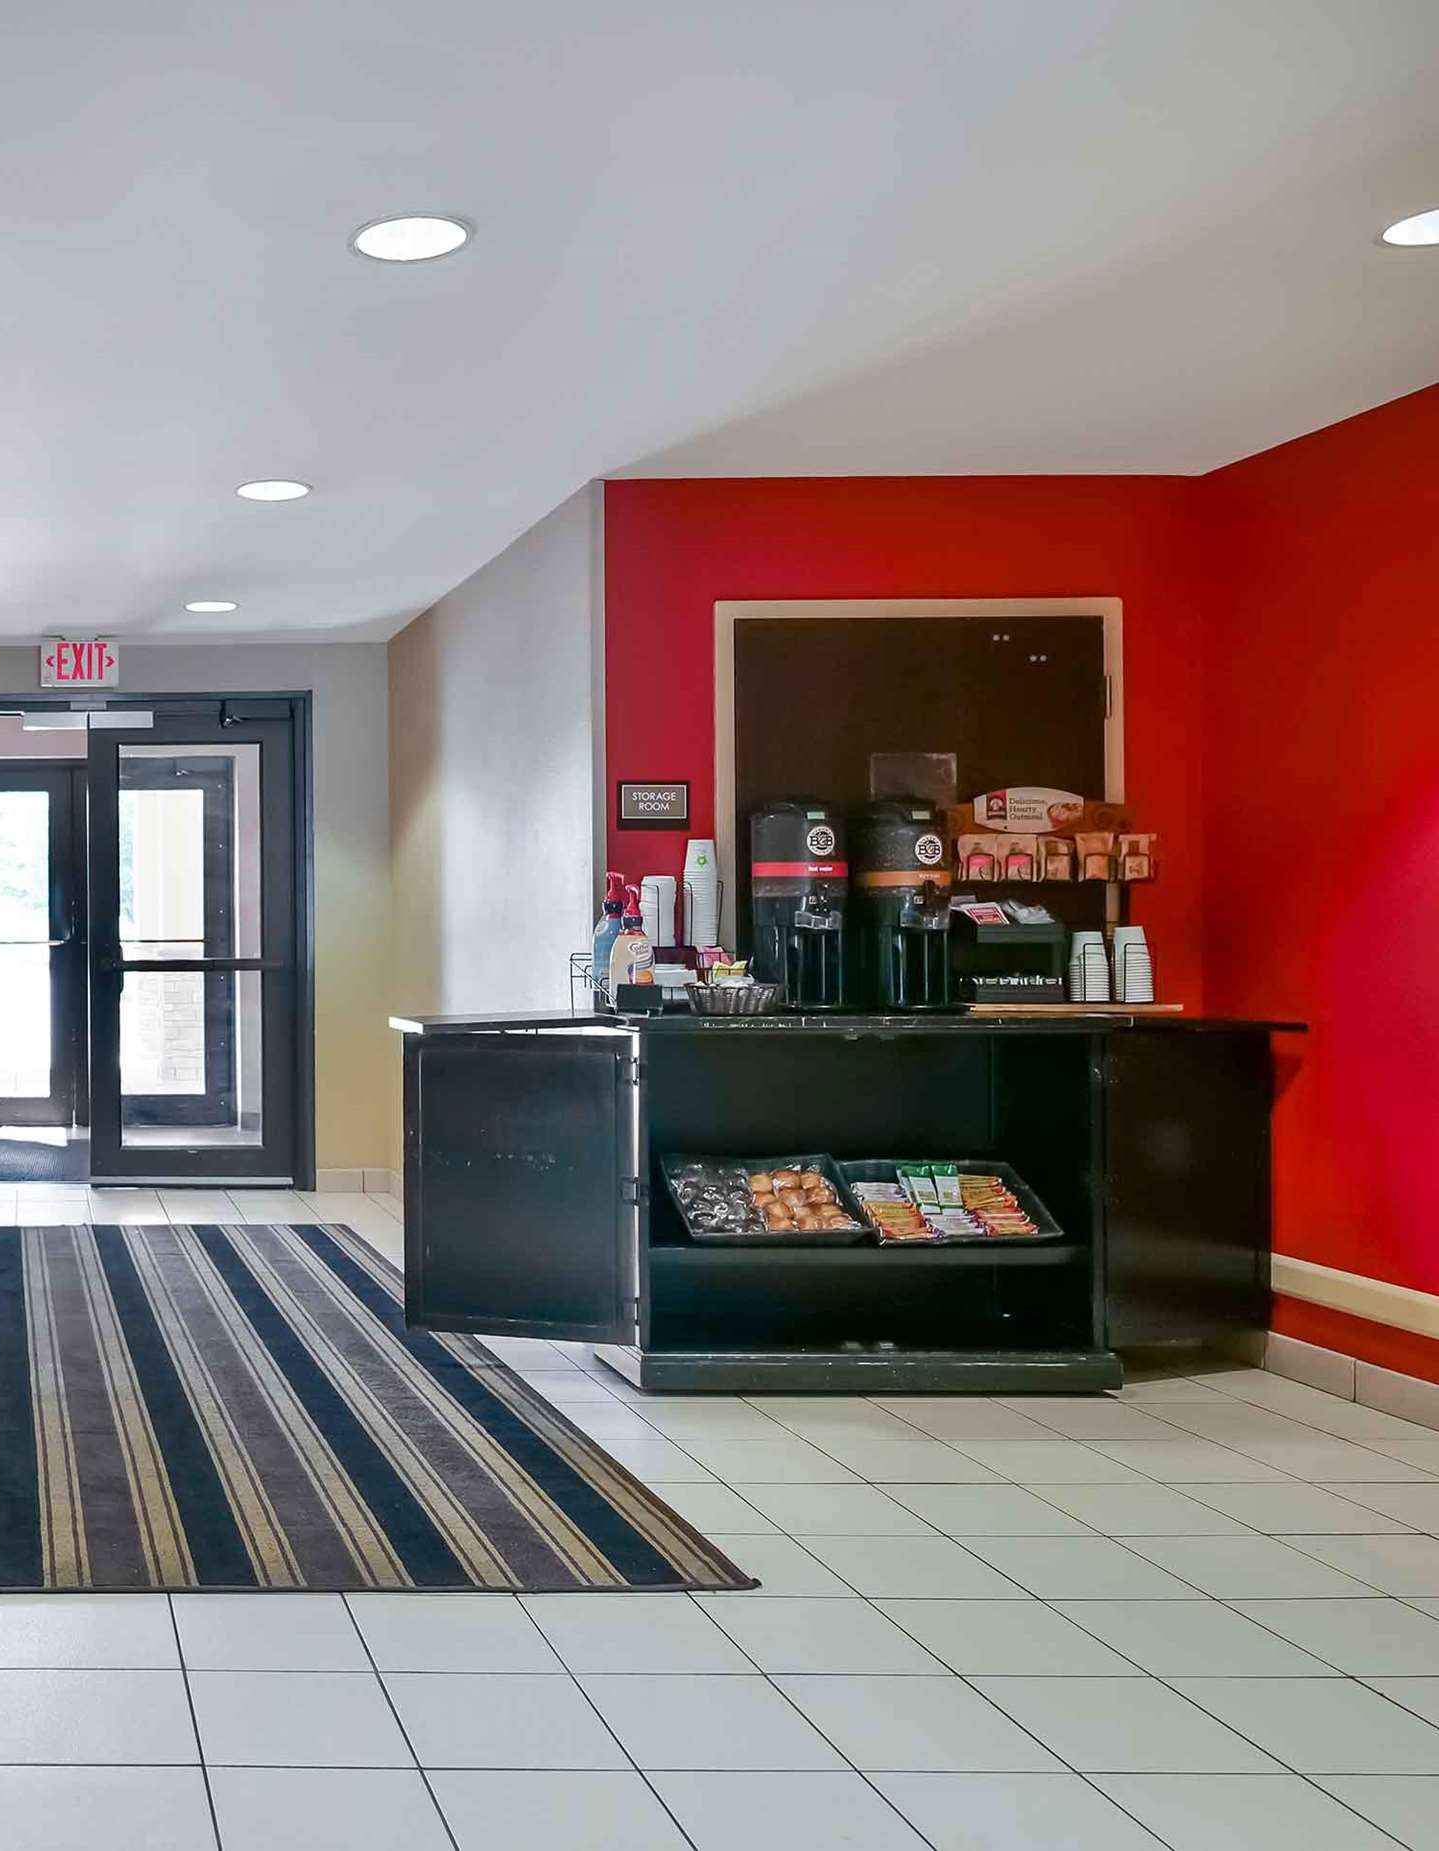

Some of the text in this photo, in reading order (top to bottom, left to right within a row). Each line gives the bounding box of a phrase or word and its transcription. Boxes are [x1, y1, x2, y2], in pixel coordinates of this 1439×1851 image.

[56, 642, 107, 680] EXIT
[632, 792, 677, 801] STORAGE
[638, 802, 670, 811] ROOM
